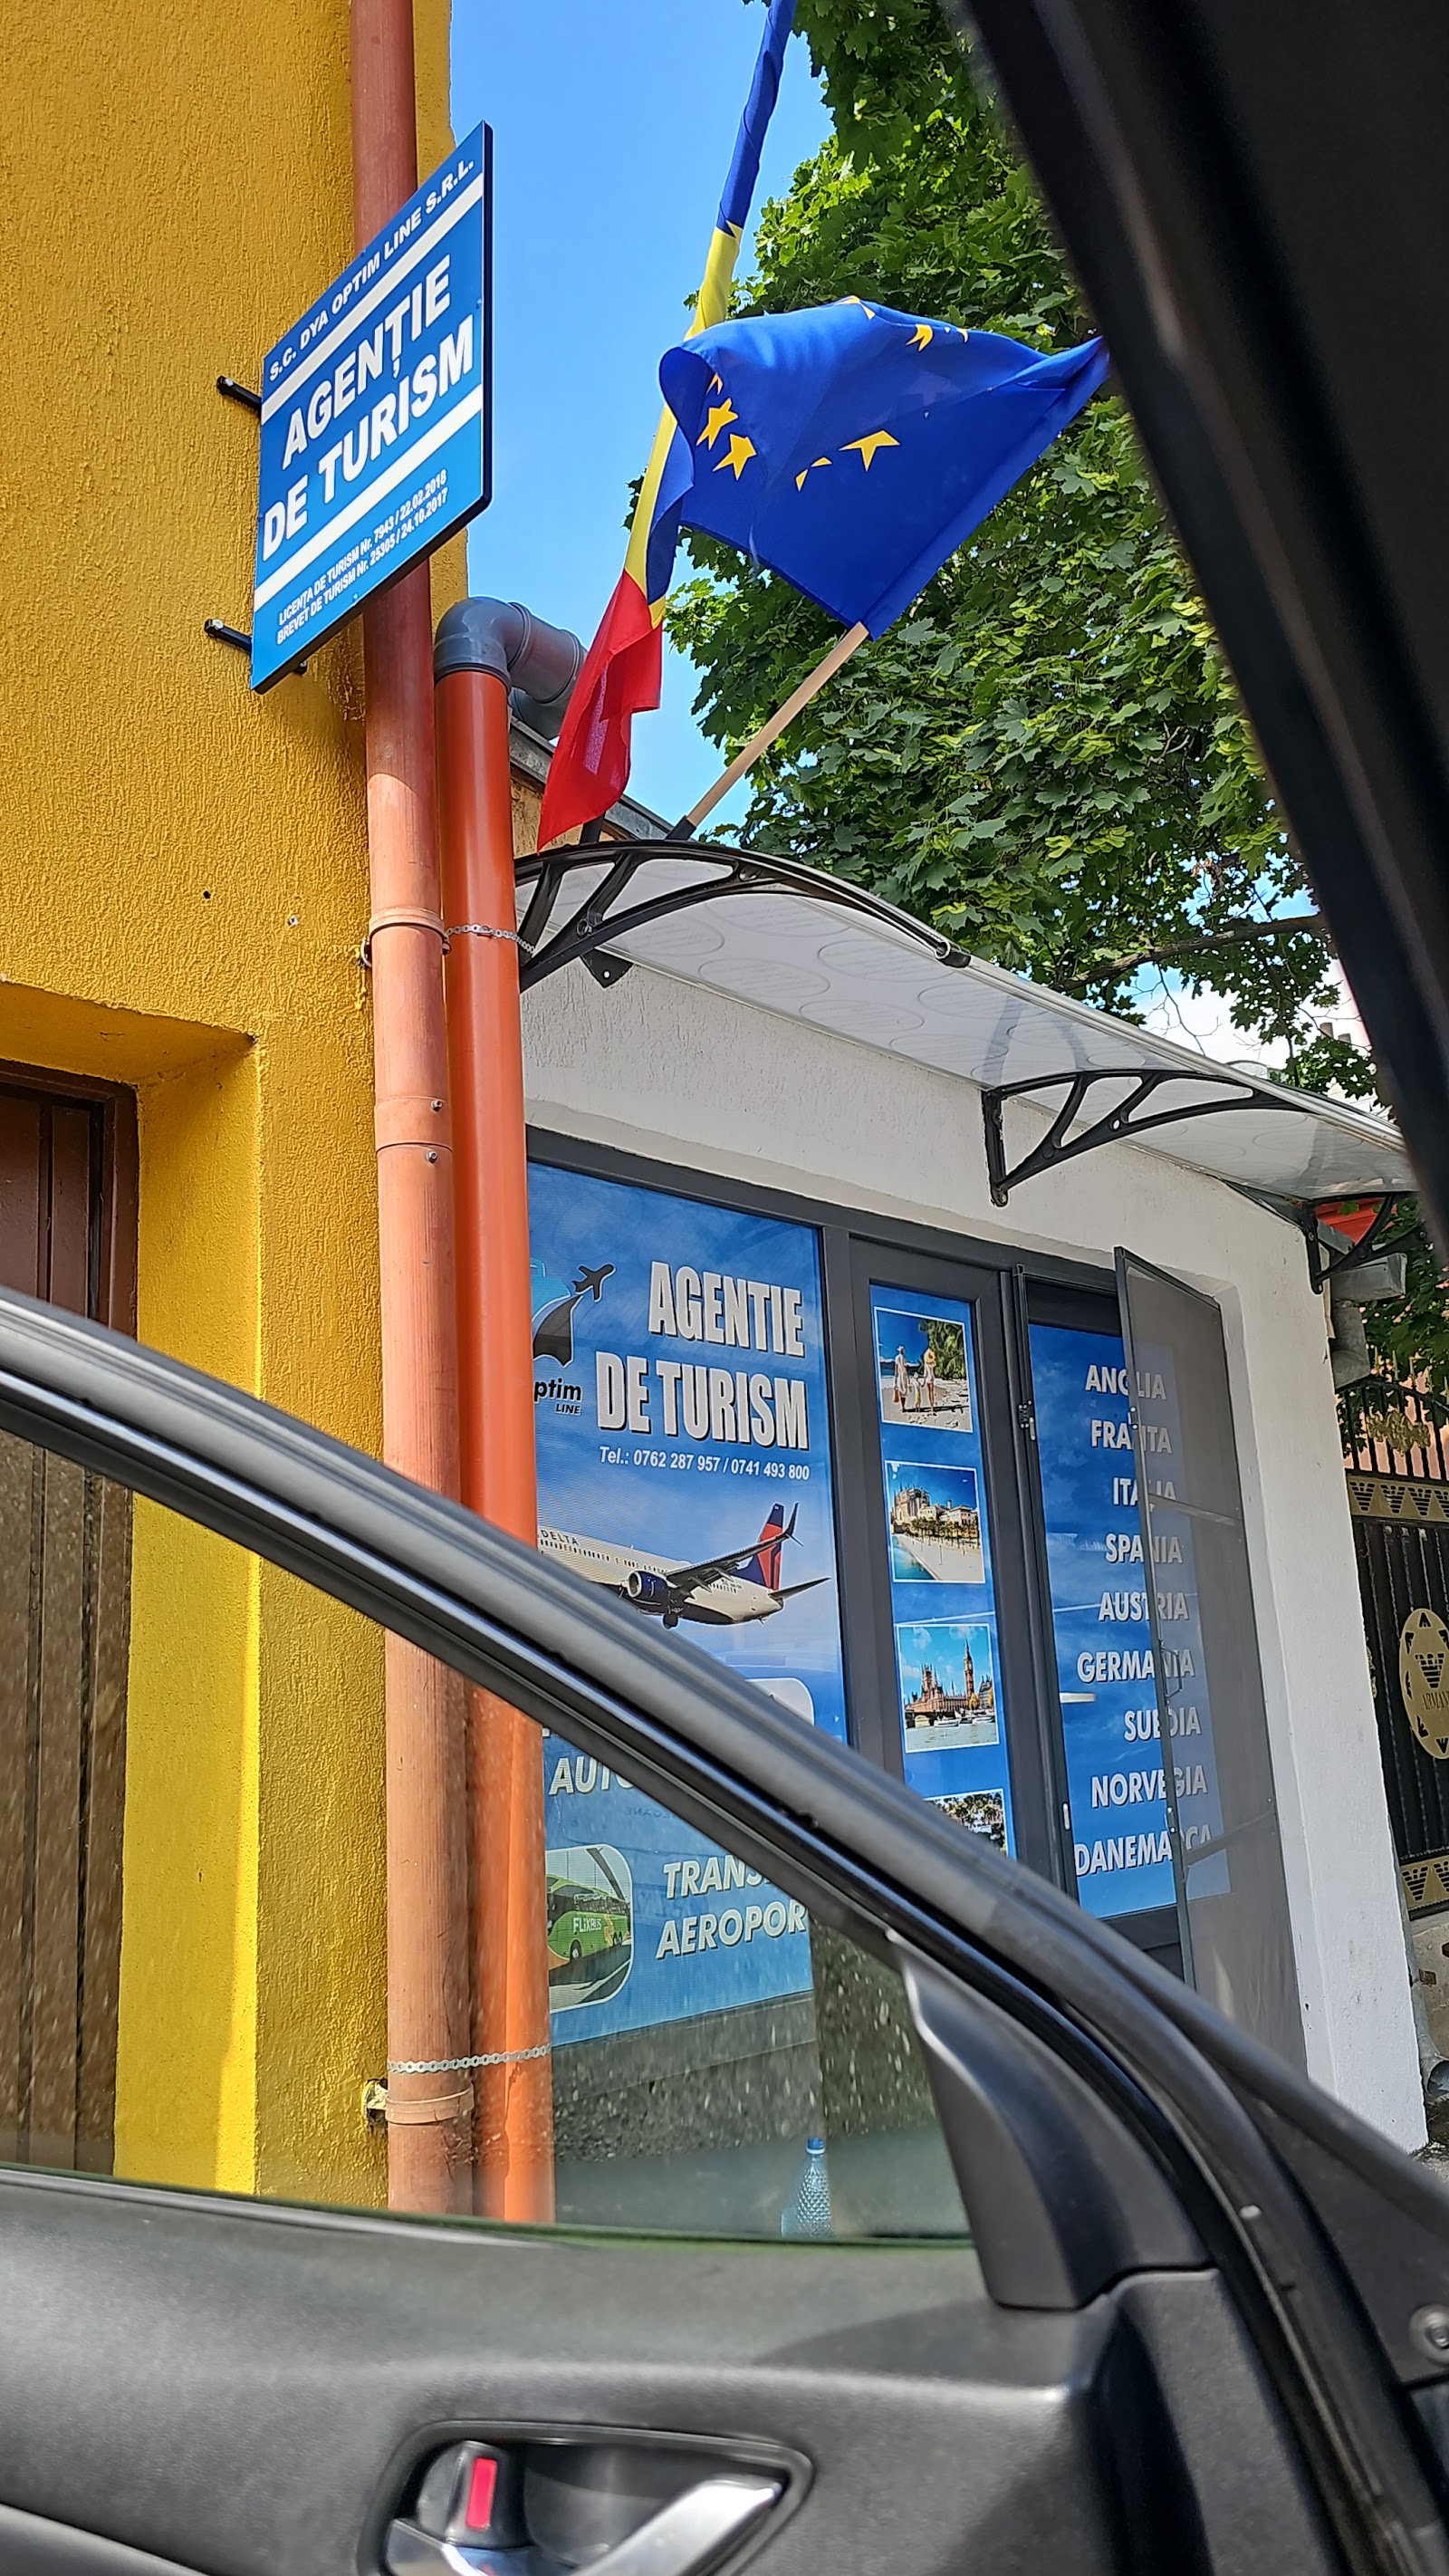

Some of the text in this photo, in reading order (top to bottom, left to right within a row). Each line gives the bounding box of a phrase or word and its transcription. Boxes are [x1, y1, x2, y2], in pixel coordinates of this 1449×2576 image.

[270, 159, 475, 381] S.C. DYA OPTIM LINE S.R.L.
[282, 254, 450, 470] AGENȚIE
[263, 314, 473, 562] DE TURISM
[277, 486, 448, 645] BREVET DE TURISM Nr. 25305 / 24.10.2017
[314, 574, 326, 596] DE
[327, 545, 360, 583] TURISM
[360, 537, 372, 555] Nr.
[374, 515, 395, 543] 7943
[395, 510, 399, 525] /
[399, 469, 446, 521] 22.02.2018
[648, 1261, 805, 1358] AGENTIE
[556, 1403, 581, 1415] LINE
[596, 1351, 809, 1451] DE TURISM
[600, 1447, 810, 1481] Tel.: 0762 287 957 / 0741 493 800
[541, 1529, 580, 1546] DELTA
[1074, 1824, 1212, 1877] DANEMACA
